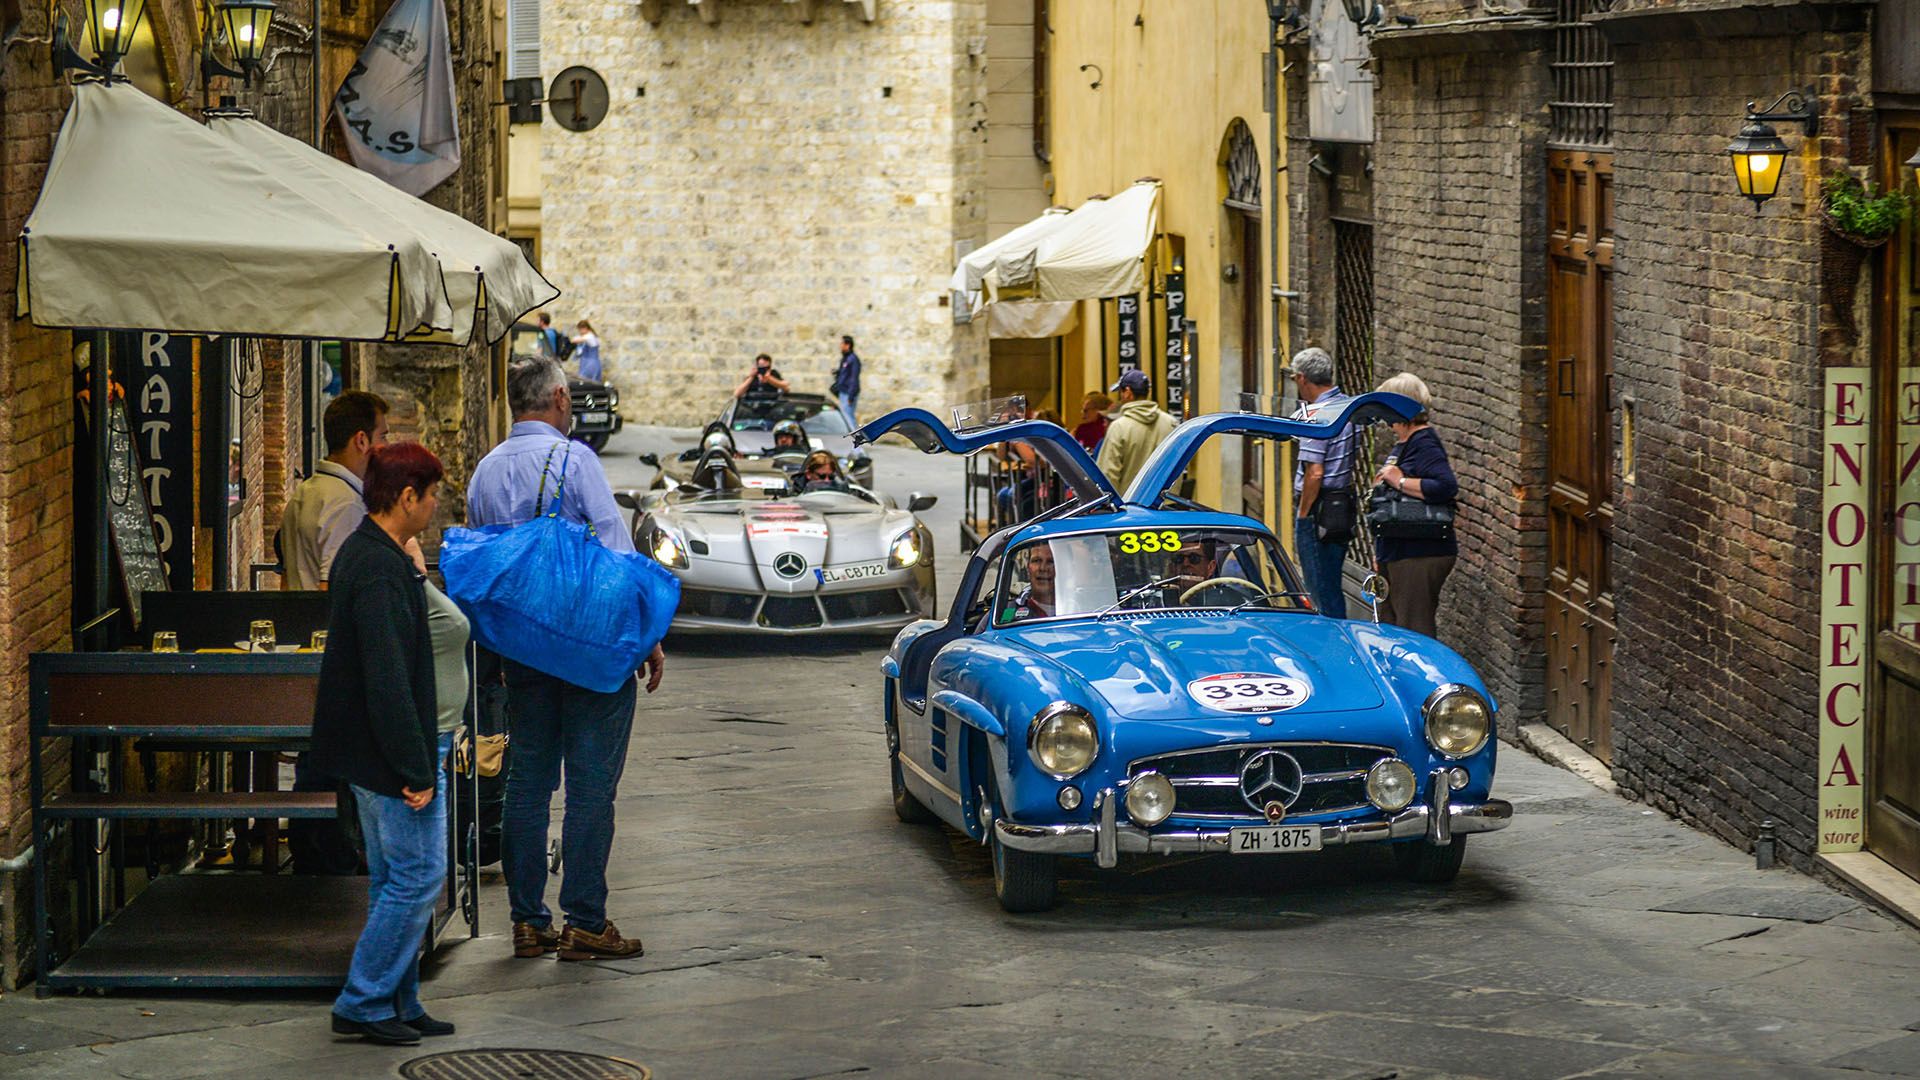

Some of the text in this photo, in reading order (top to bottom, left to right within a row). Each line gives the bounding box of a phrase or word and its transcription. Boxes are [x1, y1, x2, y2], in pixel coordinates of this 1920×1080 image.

[1119, 531, 1182, 554] 333
[1823, 382, 1866, 787] ENOTECA
[1203, 682, 1295, 699] 333
[1824, 803, 1860, 819] wine
[1823, 831, 1860, 845] store
